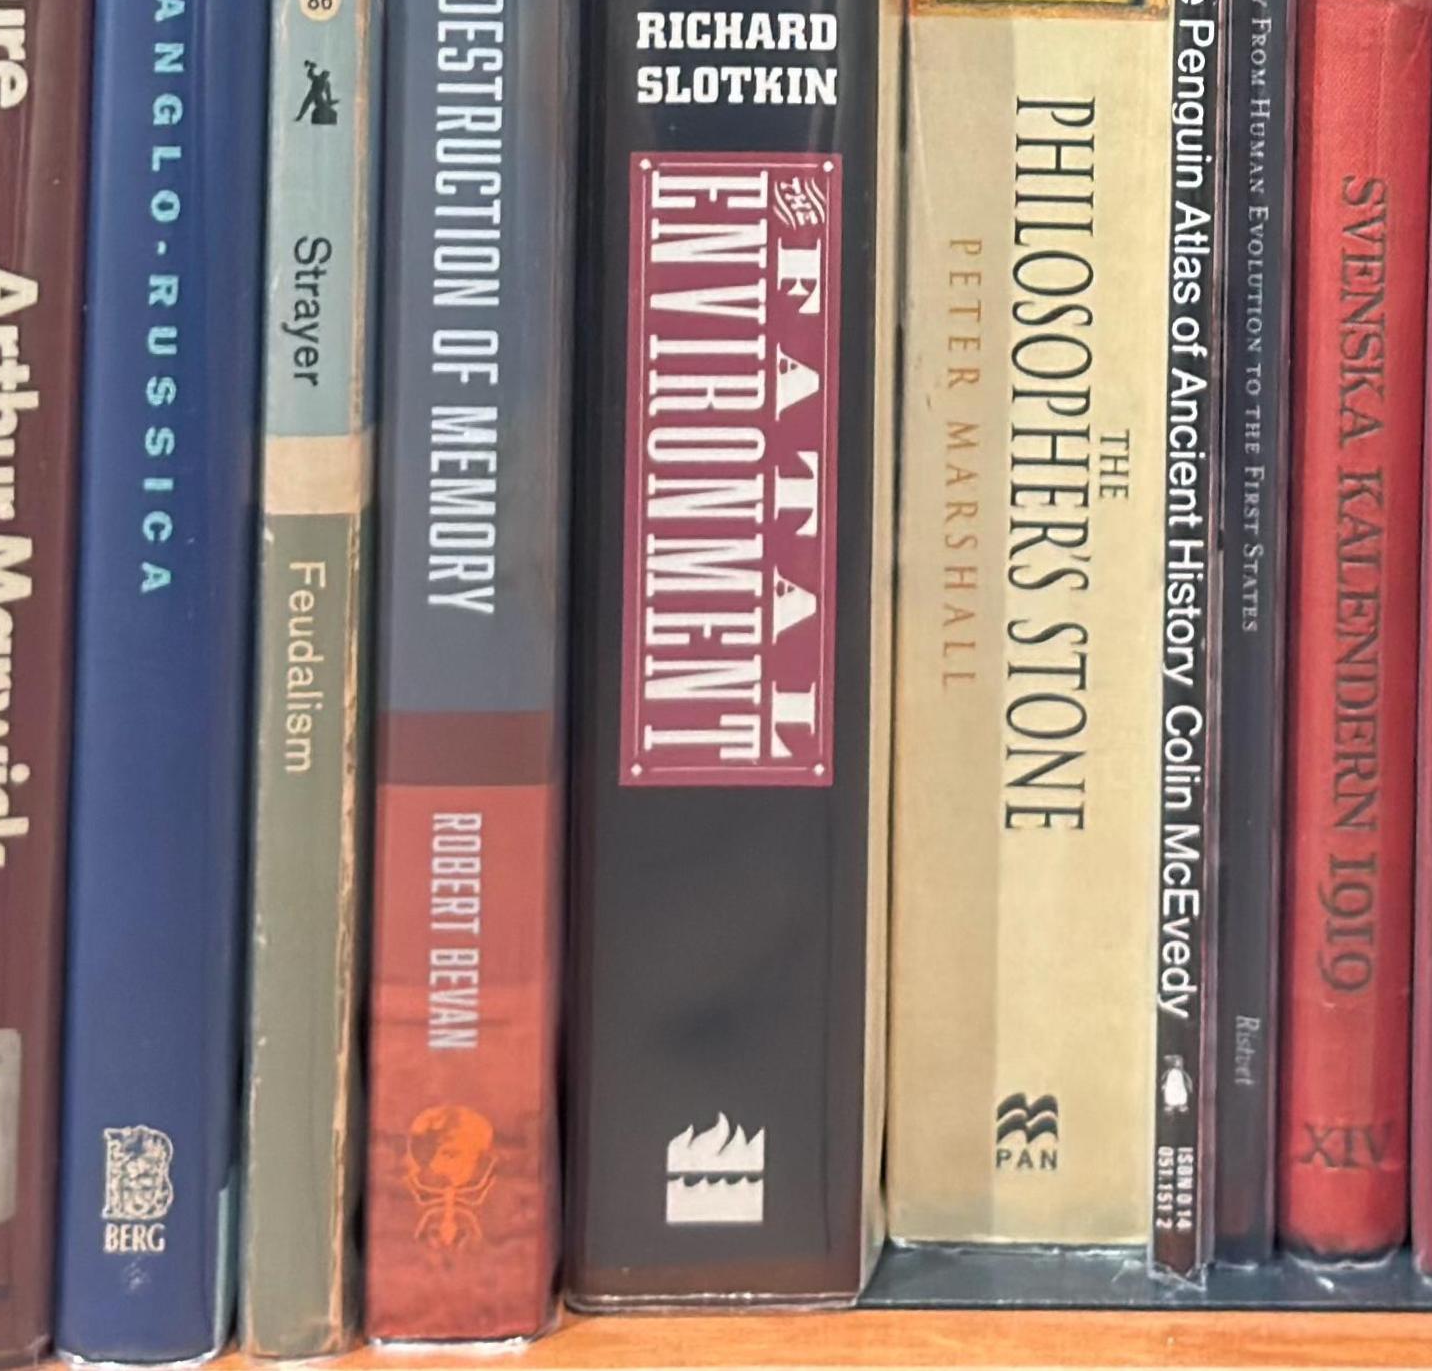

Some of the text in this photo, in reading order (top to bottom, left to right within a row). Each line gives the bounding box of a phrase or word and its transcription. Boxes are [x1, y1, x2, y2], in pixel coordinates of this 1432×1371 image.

[636, 11, 838, 51] RICHARD
[1250, 17, 1272, 86] FROM
[636, 66, 838, 105] SLOTKIN
[1172, 19, 1214, 188] Penguin
[1248, 99, 1270, 203] HUMAN
[1172, 200, 1211, 304] Atlas
[1245, 206, 1269, 352] EVOLUTION
[282, 236, 332, 386] Strayer
[430, 328, 500, 387] OF
[1171, 317, 1208, 357] of
[1337, 173, 1388, 447] SVENSKA
[1244, 409, 1261, 453] THE
[1245, 363, 1261, 395] TO
[643, 169, 769, 762] ENVIRONMENT
[769, 176, 823, 758] THE FATAL
[941, 238, 983, 689] PETER MARSHALL
[1004, 96, 1096, 830] PHILOSOPHER'S STONE
[1098, 429, 1130, 499] THE
[1168, 368, 1208, 528] Ancient
[1244, 466, 1265, 535] FIRST
[427, 405, 498, 615] MEMORY
[1162, 539, 1205, 686] History
[1242, 543, 1264, 632] STATES
[283, 562, 326, 774] Feudalism
[1333, 466, 1385, 830] KALENDERN
[1164, 705, 1203, 810] Colin
[426, 812, 483, 1050] ROBERT BEVAN
[1157, 824, 1200, 1019] McEvedy
[996, 1149, 1059, 1170] PAN
[1298, 1122, 1398, 1169] XIV
[103, 1223, 166, 1253] BERG
